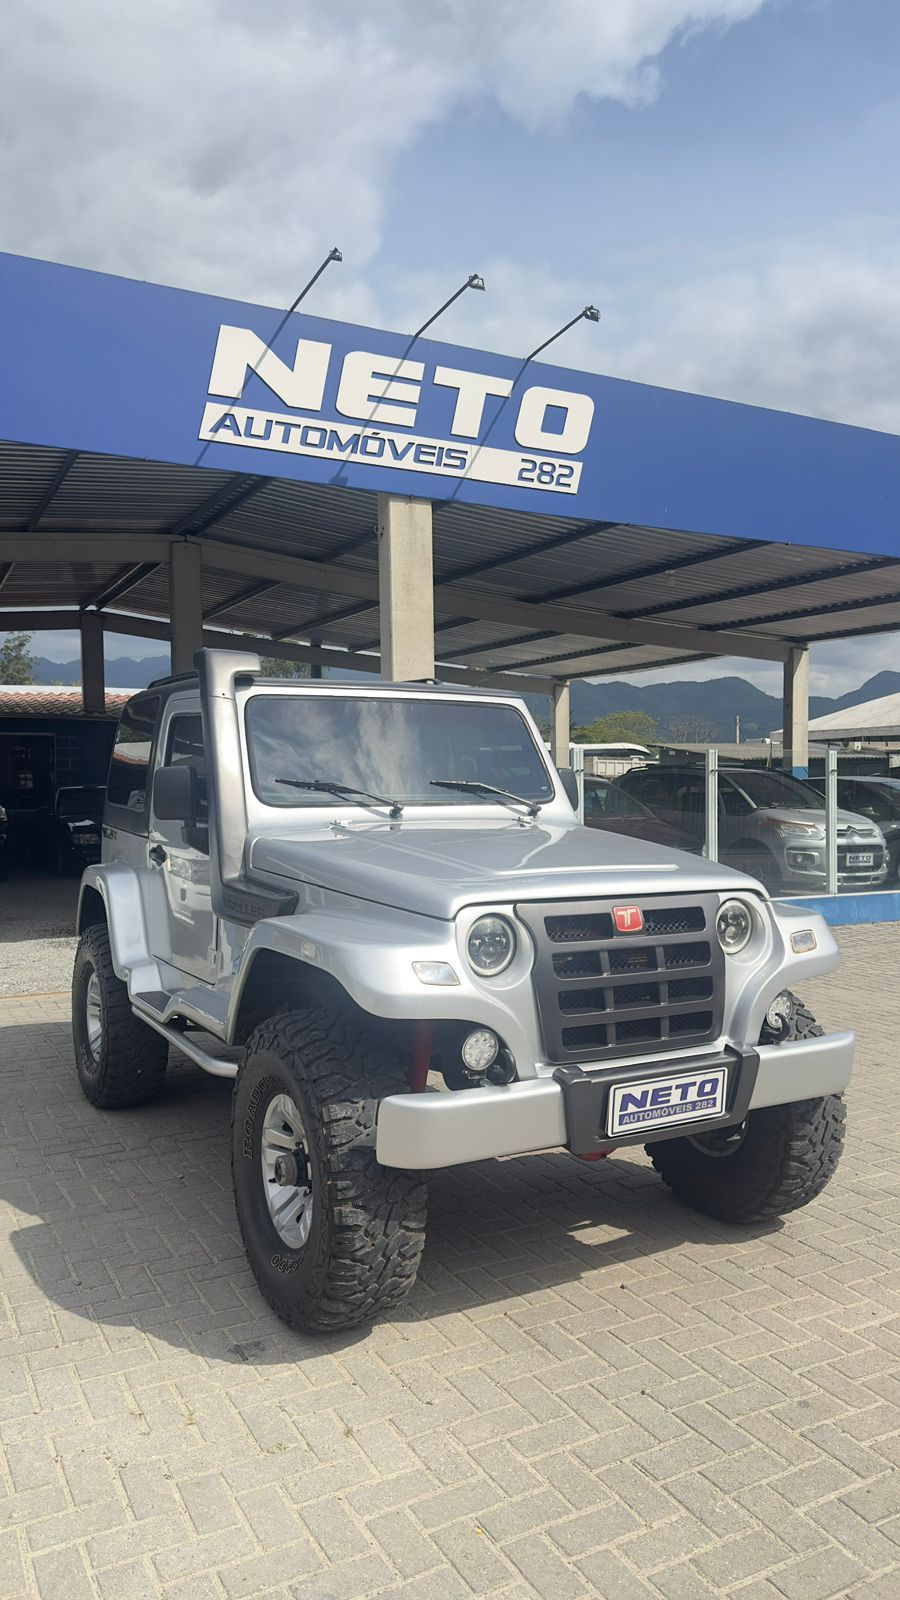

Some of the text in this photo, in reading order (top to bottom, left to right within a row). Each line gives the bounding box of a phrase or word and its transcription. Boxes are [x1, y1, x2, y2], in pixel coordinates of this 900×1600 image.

[207, 324, 595, 455] NETO
[209, 413, 574, 489] AUTOMÓVEIS 282
[619, 1078, 719, 1112] NETO
[622, 1099, 714, 1125] AUTOMÓVEIS 282
